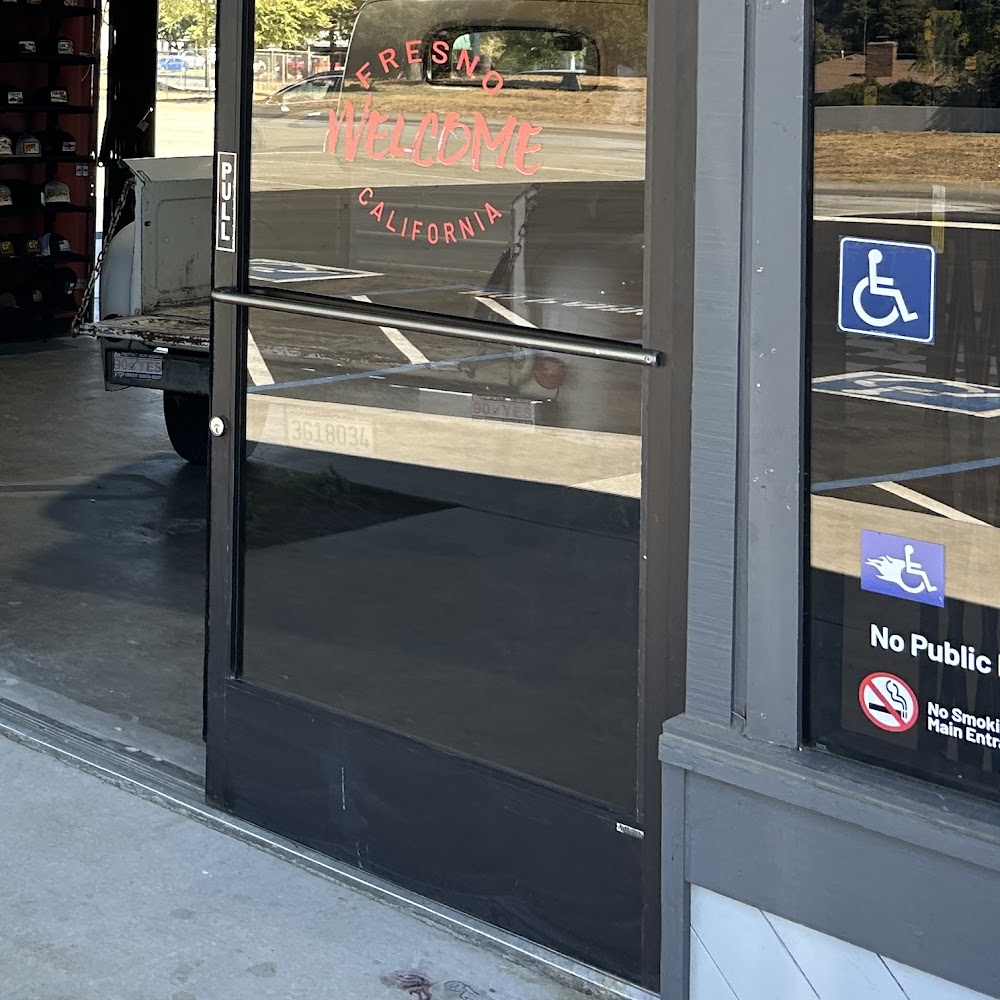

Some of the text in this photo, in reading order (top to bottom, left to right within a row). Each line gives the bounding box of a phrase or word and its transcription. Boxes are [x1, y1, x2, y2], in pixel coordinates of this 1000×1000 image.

[356, 40, 503, 95] FRESNO
[327, 93, 543, 175] WELCOME
[220, 162, 232, 240] PULL
[358, 187, 502, 244] CALIFORNIA
[502, 404, 531, 419] YES
[870, 624, 905, 652] No
[911, 633, 992, 674] Public
[927, 717, 1000, 749] Main Entr
[928, 701, 1000, 733] No Smoki
